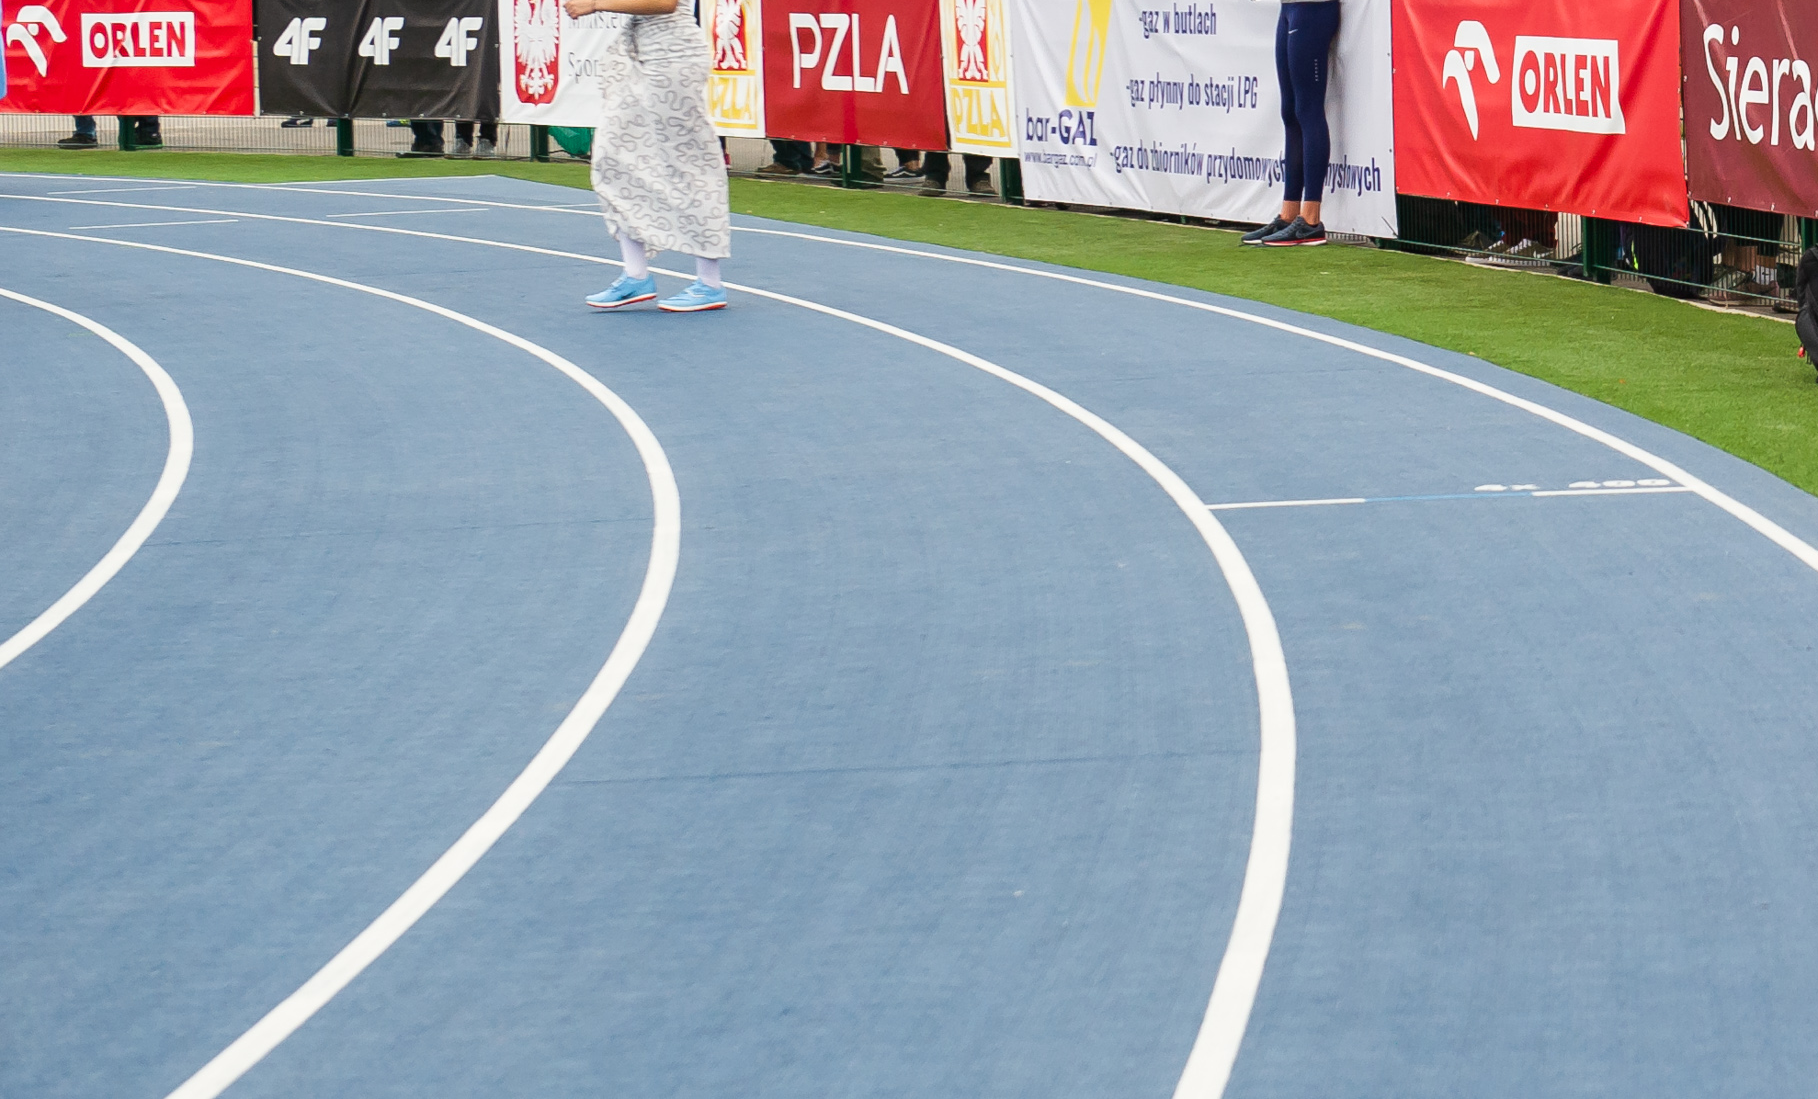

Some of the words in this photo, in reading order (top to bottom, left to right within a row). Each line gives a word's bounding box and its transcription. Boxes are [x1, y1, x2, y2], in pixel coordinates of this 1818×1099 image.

[89, 19, 187, 60] ORLEN
[272, 17, 327, 65] 4F
[358, 16, 404, 66] 4F
[434, 16, 484, 67] 4F
[1139, 10, 1159, 39] -gaz
[1162, 12, 1171, 35] w
[1172, 3, 1217, 36] butlach
[568, 52, 604, 84] Spor
[788, 12, 910, 95] PZLA
[1126, 78, 1145, 107] -gaz
[1148, 72, 1184, 110] płynny
[1188, 74, 1201, 107] do
[1204, 76, 1235, 114] stacji
[1237, 76, 1258, 109] LPG
[1518, 53, 1611, 119] ORLEN
[951, 87, 1006, 139] PZLA
[1025, 107, 1098, 147] bar-GAZ
[1110, 146, 1134, 174] -gaz
[1137, 139, 1149, 171] do
[1150, 140, 1205, 177] zbiorników
